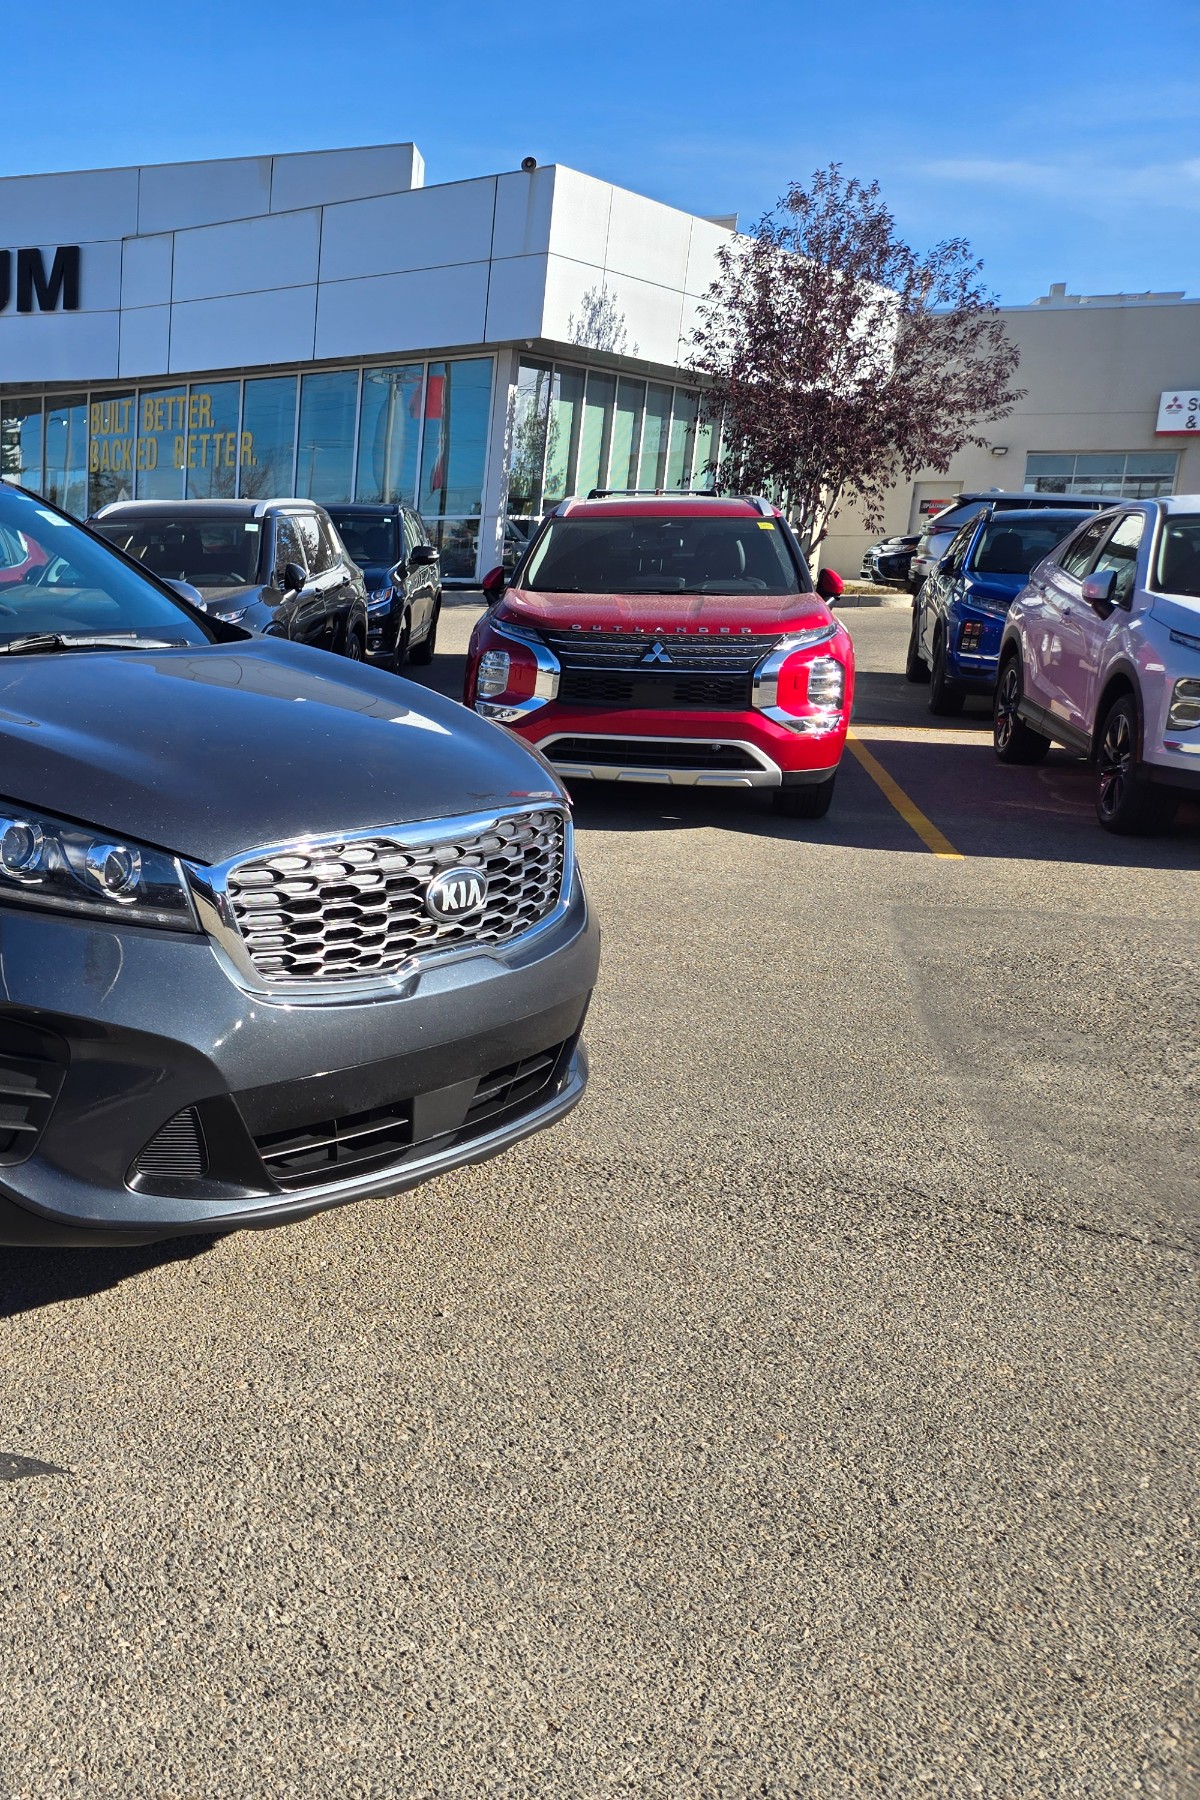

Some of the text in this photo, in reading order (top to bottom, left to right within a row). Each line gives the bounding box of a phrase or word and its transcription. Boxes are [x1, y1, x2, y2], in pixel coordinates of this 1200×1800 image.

[90, 393, 215, 436] BUILT BETTER.
[1187, 397, 1200, 412] S
[1185, 415, 1197, 429] &
[89, 432, 258, 473] BACKED BETTER.
[571, 624, 752, 634] OUTLANDER
[441, 878, 481, 912] KIA
